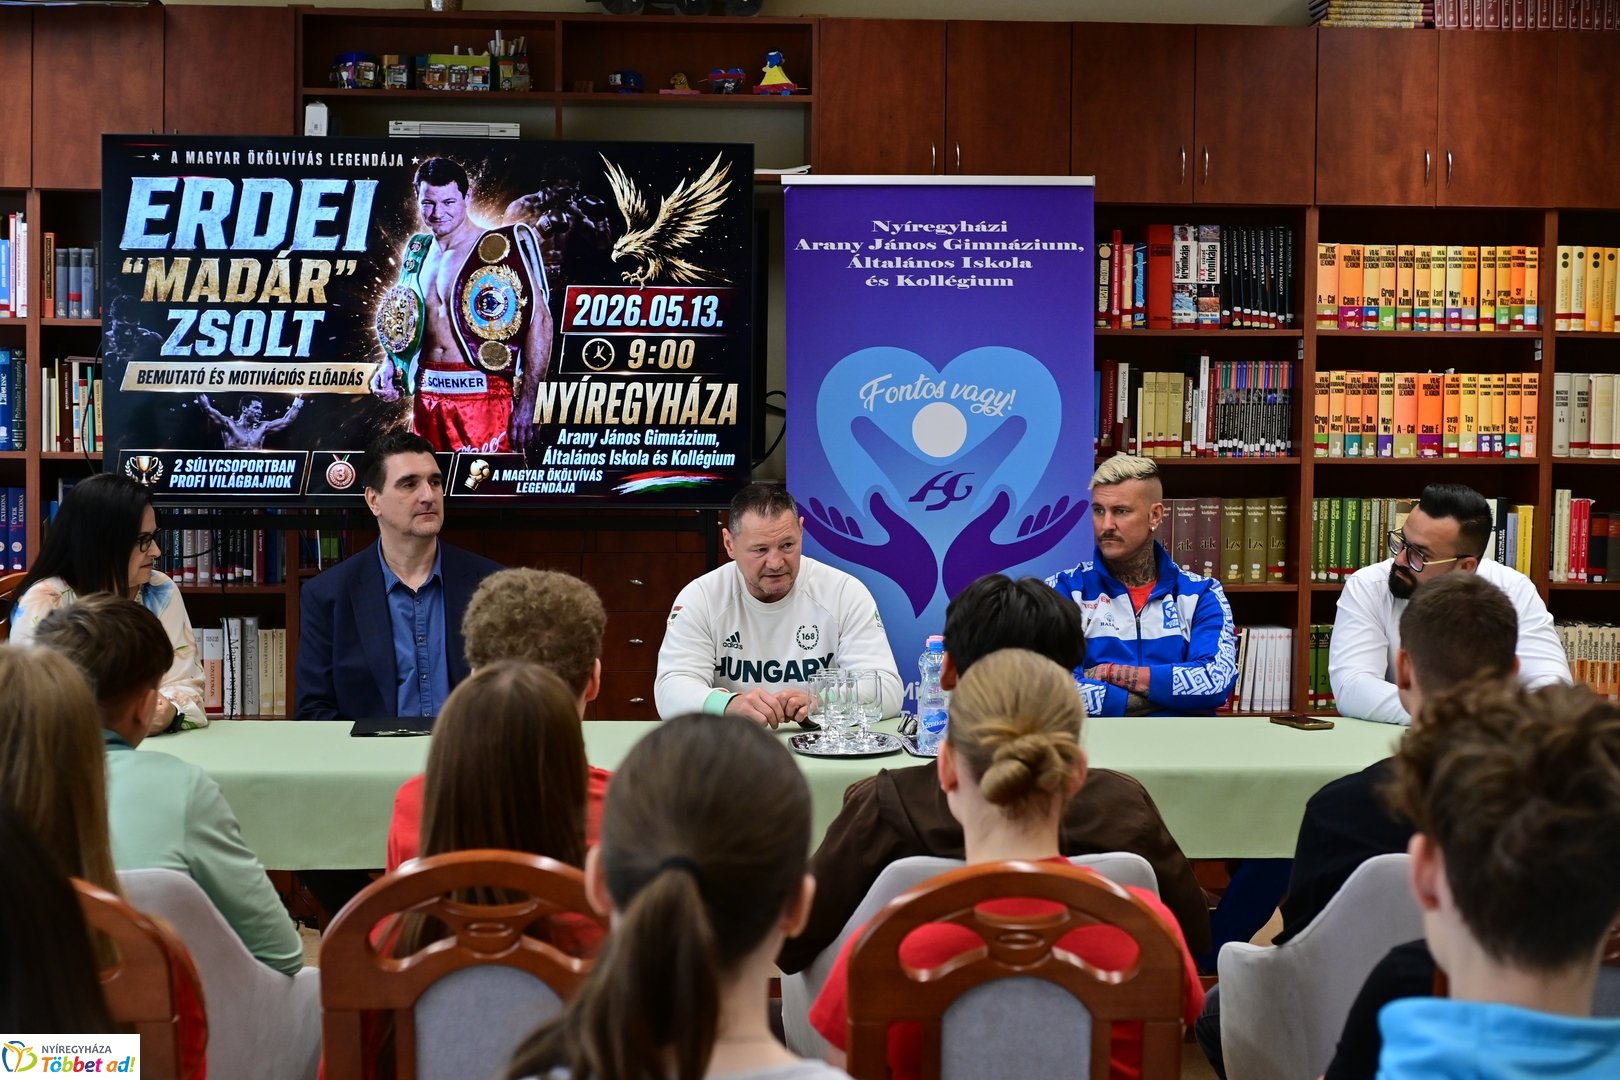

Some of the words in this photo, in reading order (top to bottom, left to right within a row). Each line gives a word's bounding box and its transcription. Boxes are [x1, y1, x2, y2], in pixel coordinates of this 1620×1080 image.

[170, 151, 178, 164] A
[186, 150, 240, 165] MAGYAR
[248, 150, 323, 166] ÖKÖLVÍVÁS
[330, 150, 404, 167] LEGENDÁJA
[120, 176, 379, 252] ERDEI
[871, 220, 1008, 235] Nyíregyházi
[795, 238, 864, 254] Arany
[868, 238, 937, 251] János
[942, 238, 1084, 253] Gimnázium,
[846, 254, 955, 269] Általános
[961, 256, 1034, 269] Iskola
[865, 274, 889, 288] és
[896, 274, 1014, 290] Kollégium
[572, 294, 724, 327] 2026.05.13.
[160, 309, 326, 357] ZSOLT
[628, 338, 696, 370] 9:00
[137, 368, 205, 385] BEMUTATÓ
[208, 368, 224, 385] ÉS
[228, 368, 304, 385] MOTIVÁCIÓS
[308, 368, 364, 386] ELŐADÁS
[428, 376, 484, 388] SCHENKER
[532, 375, 738, 425] NYÍREGYHÁZA
[860, 373, 947, 412] Fontos
[950, 384, 1016, 417] vagy!
[557, 428, 598, 448] Arany
[600, 428, 641, 446] János
[644, 429, 720, 448] Gimnázium,
[174, 459, 182, 472] 2
[185, 456, 296, 474] SÚLYCSOPORTBAN
[542, 446, 606, 466] Általános
[609, 450, 649, 466] Iskola
[652, 452, 668, 466] és
[670, 450, 736, 469] Kollégium
[169, 474, 206, 488] PROFI
[209, 472, 292, 488] VILÁGBAJNOK
[492, 470, 500, 481] A
[502, 470, 545, 482] MAGYAR
[547, 468, 603, 482] ÖKÖLVÍVÁS
[516, 480, 576, 494] LEGENDÁJA
[802, 632, 815, 641] 168
[714, 652, 835, 684] HUNGARY
